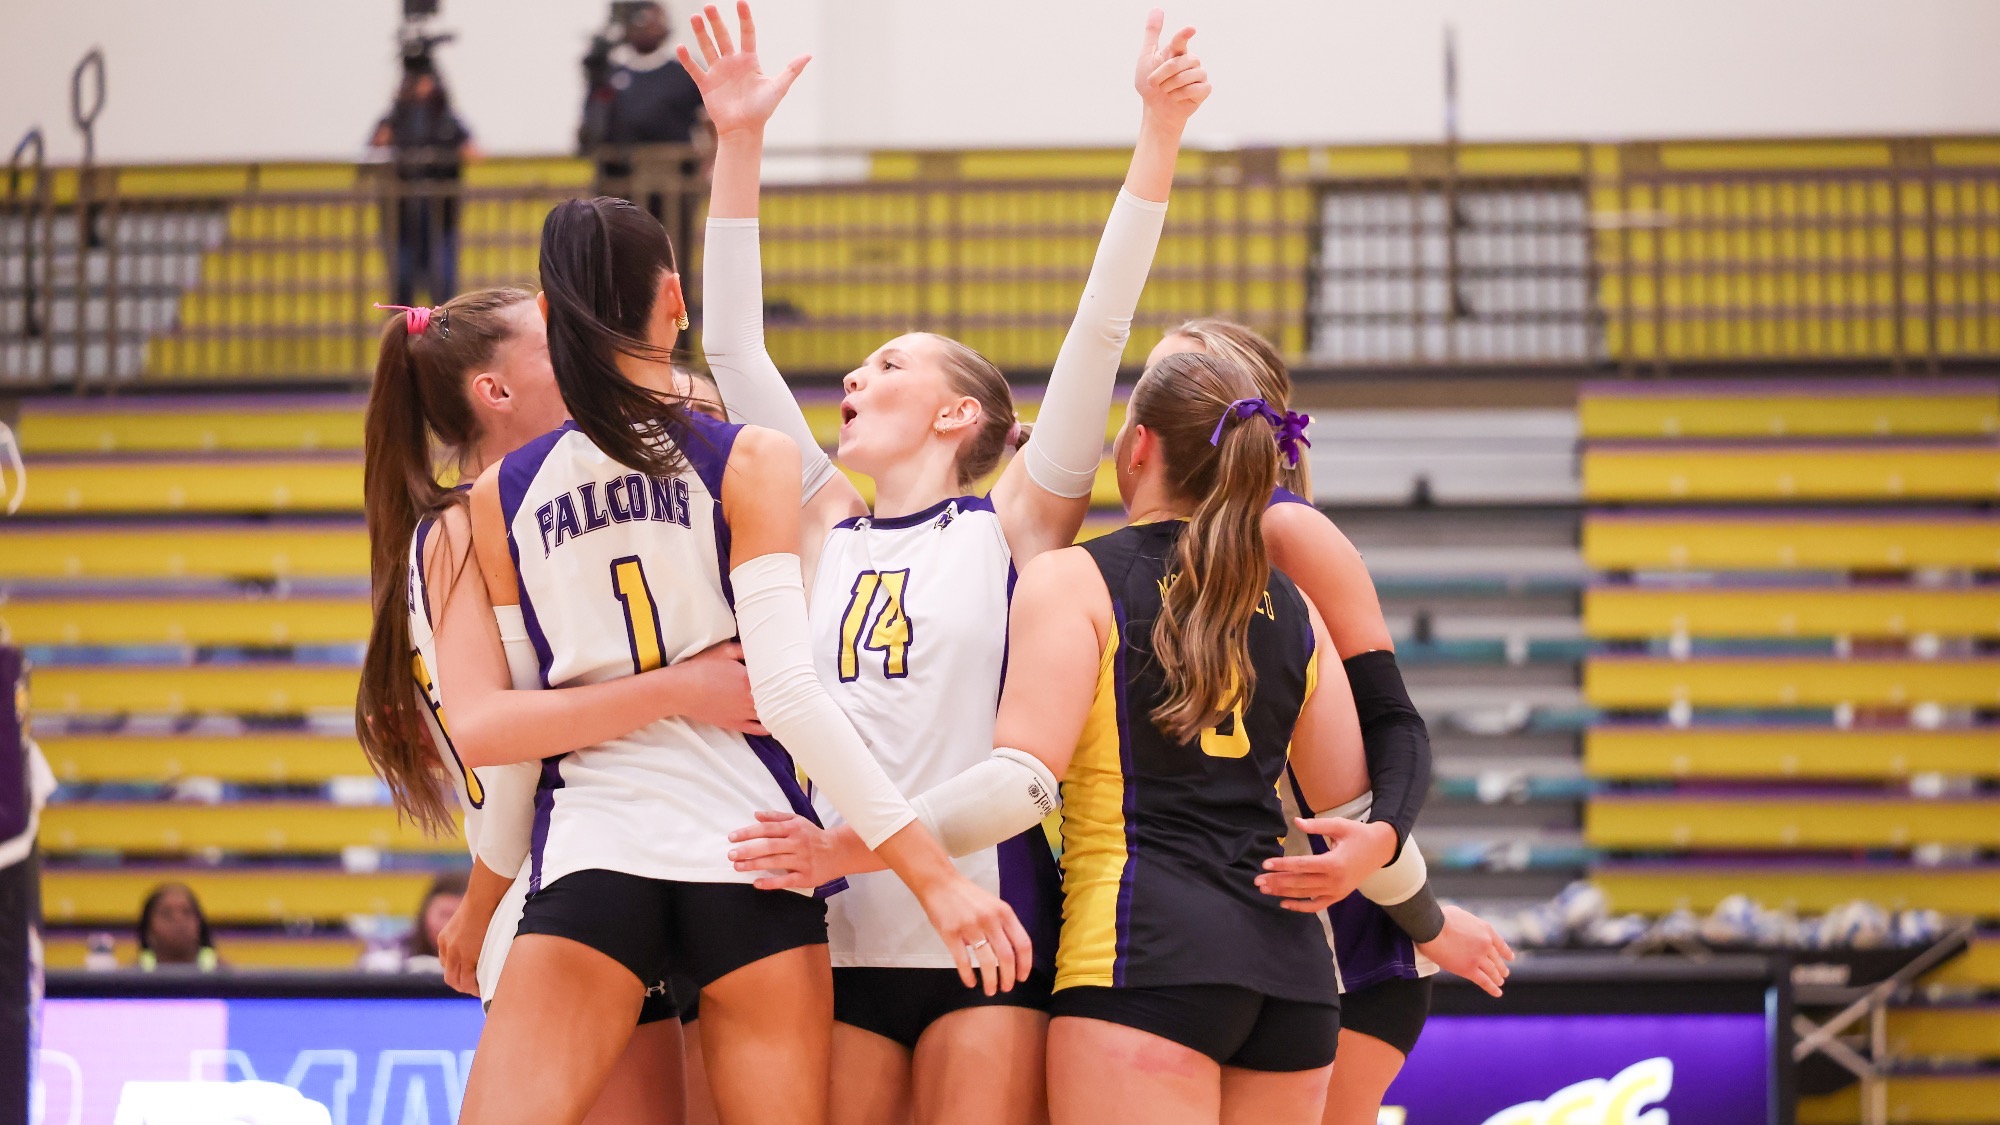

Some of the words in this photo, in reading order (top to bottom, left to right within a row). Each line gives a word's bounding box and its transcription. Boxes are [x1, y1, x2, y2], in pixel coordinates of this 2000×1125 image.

[535, 473, 691, 559] FALCONS
[610, 555, 667, 674] 1
[838, 568, 913, 683] 14
